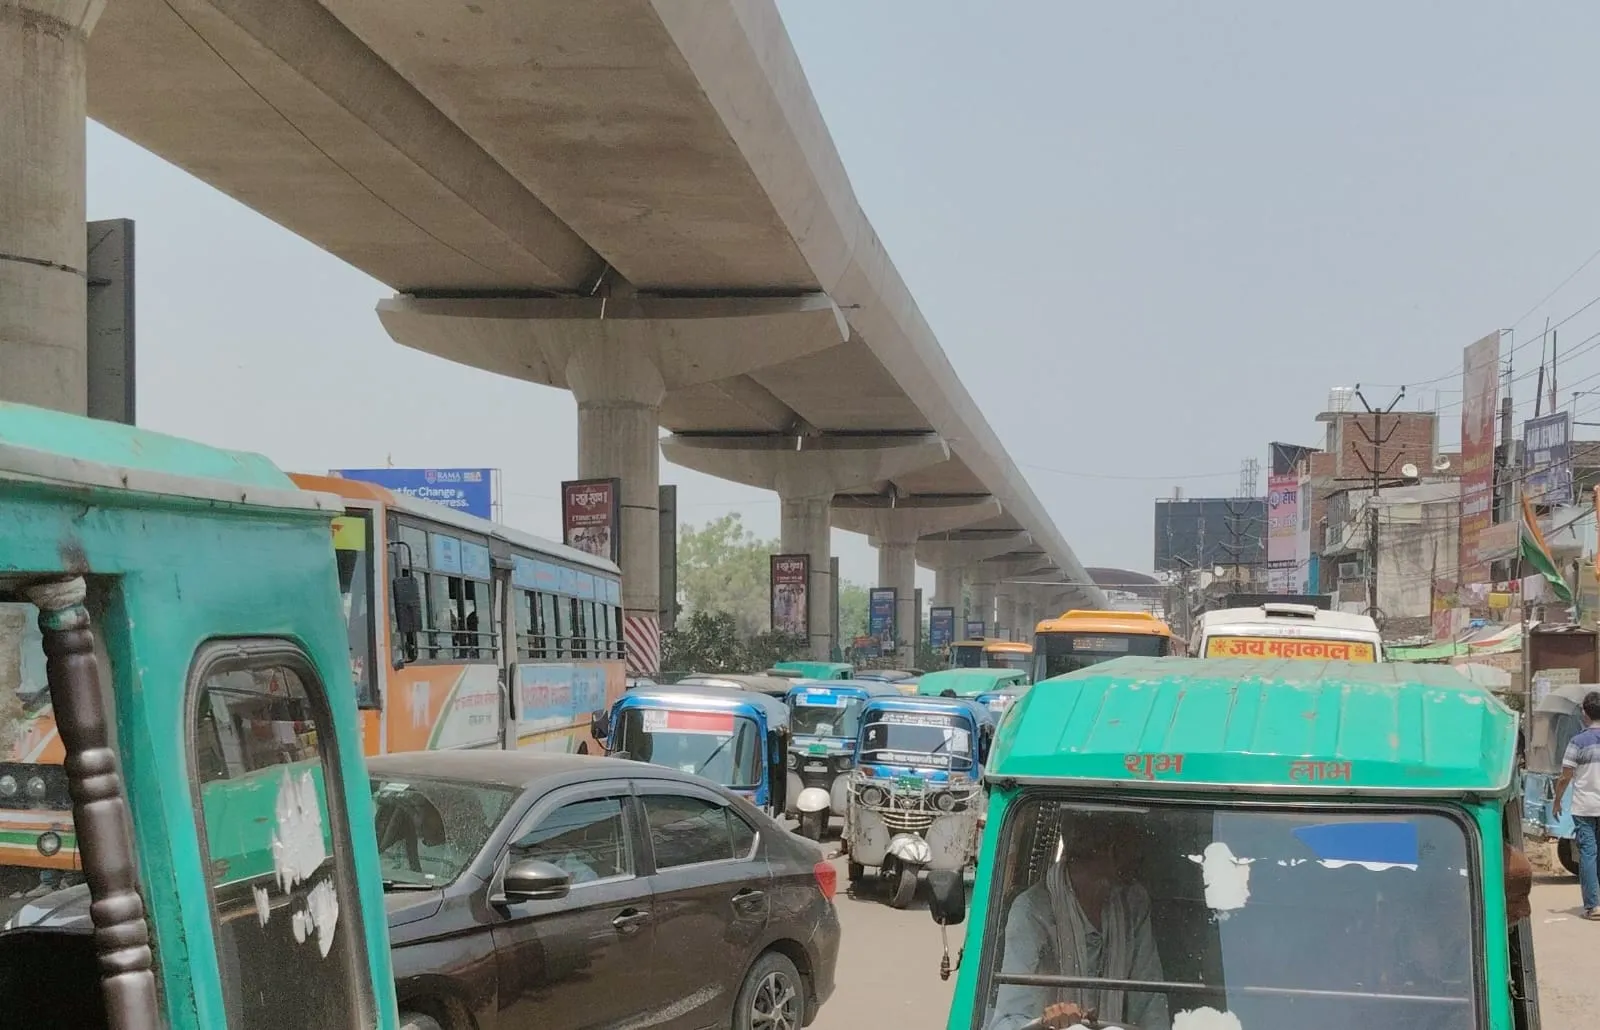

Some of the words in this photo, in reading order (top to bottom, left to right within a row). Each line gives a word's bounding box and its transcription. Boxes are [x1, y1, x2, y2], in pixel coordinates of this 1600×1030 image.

[437, 472, 461, 480] RAMA
[403, 487, 417, 497] for
[419, 486, 456, 499] Change
[1230, 639, 1264, 656] जय
[1269, 640, 1350, 660] महाकाल
[1124, 753, 1185, 780] शुभ
[1289, 760, 1352, 782] लाभ
